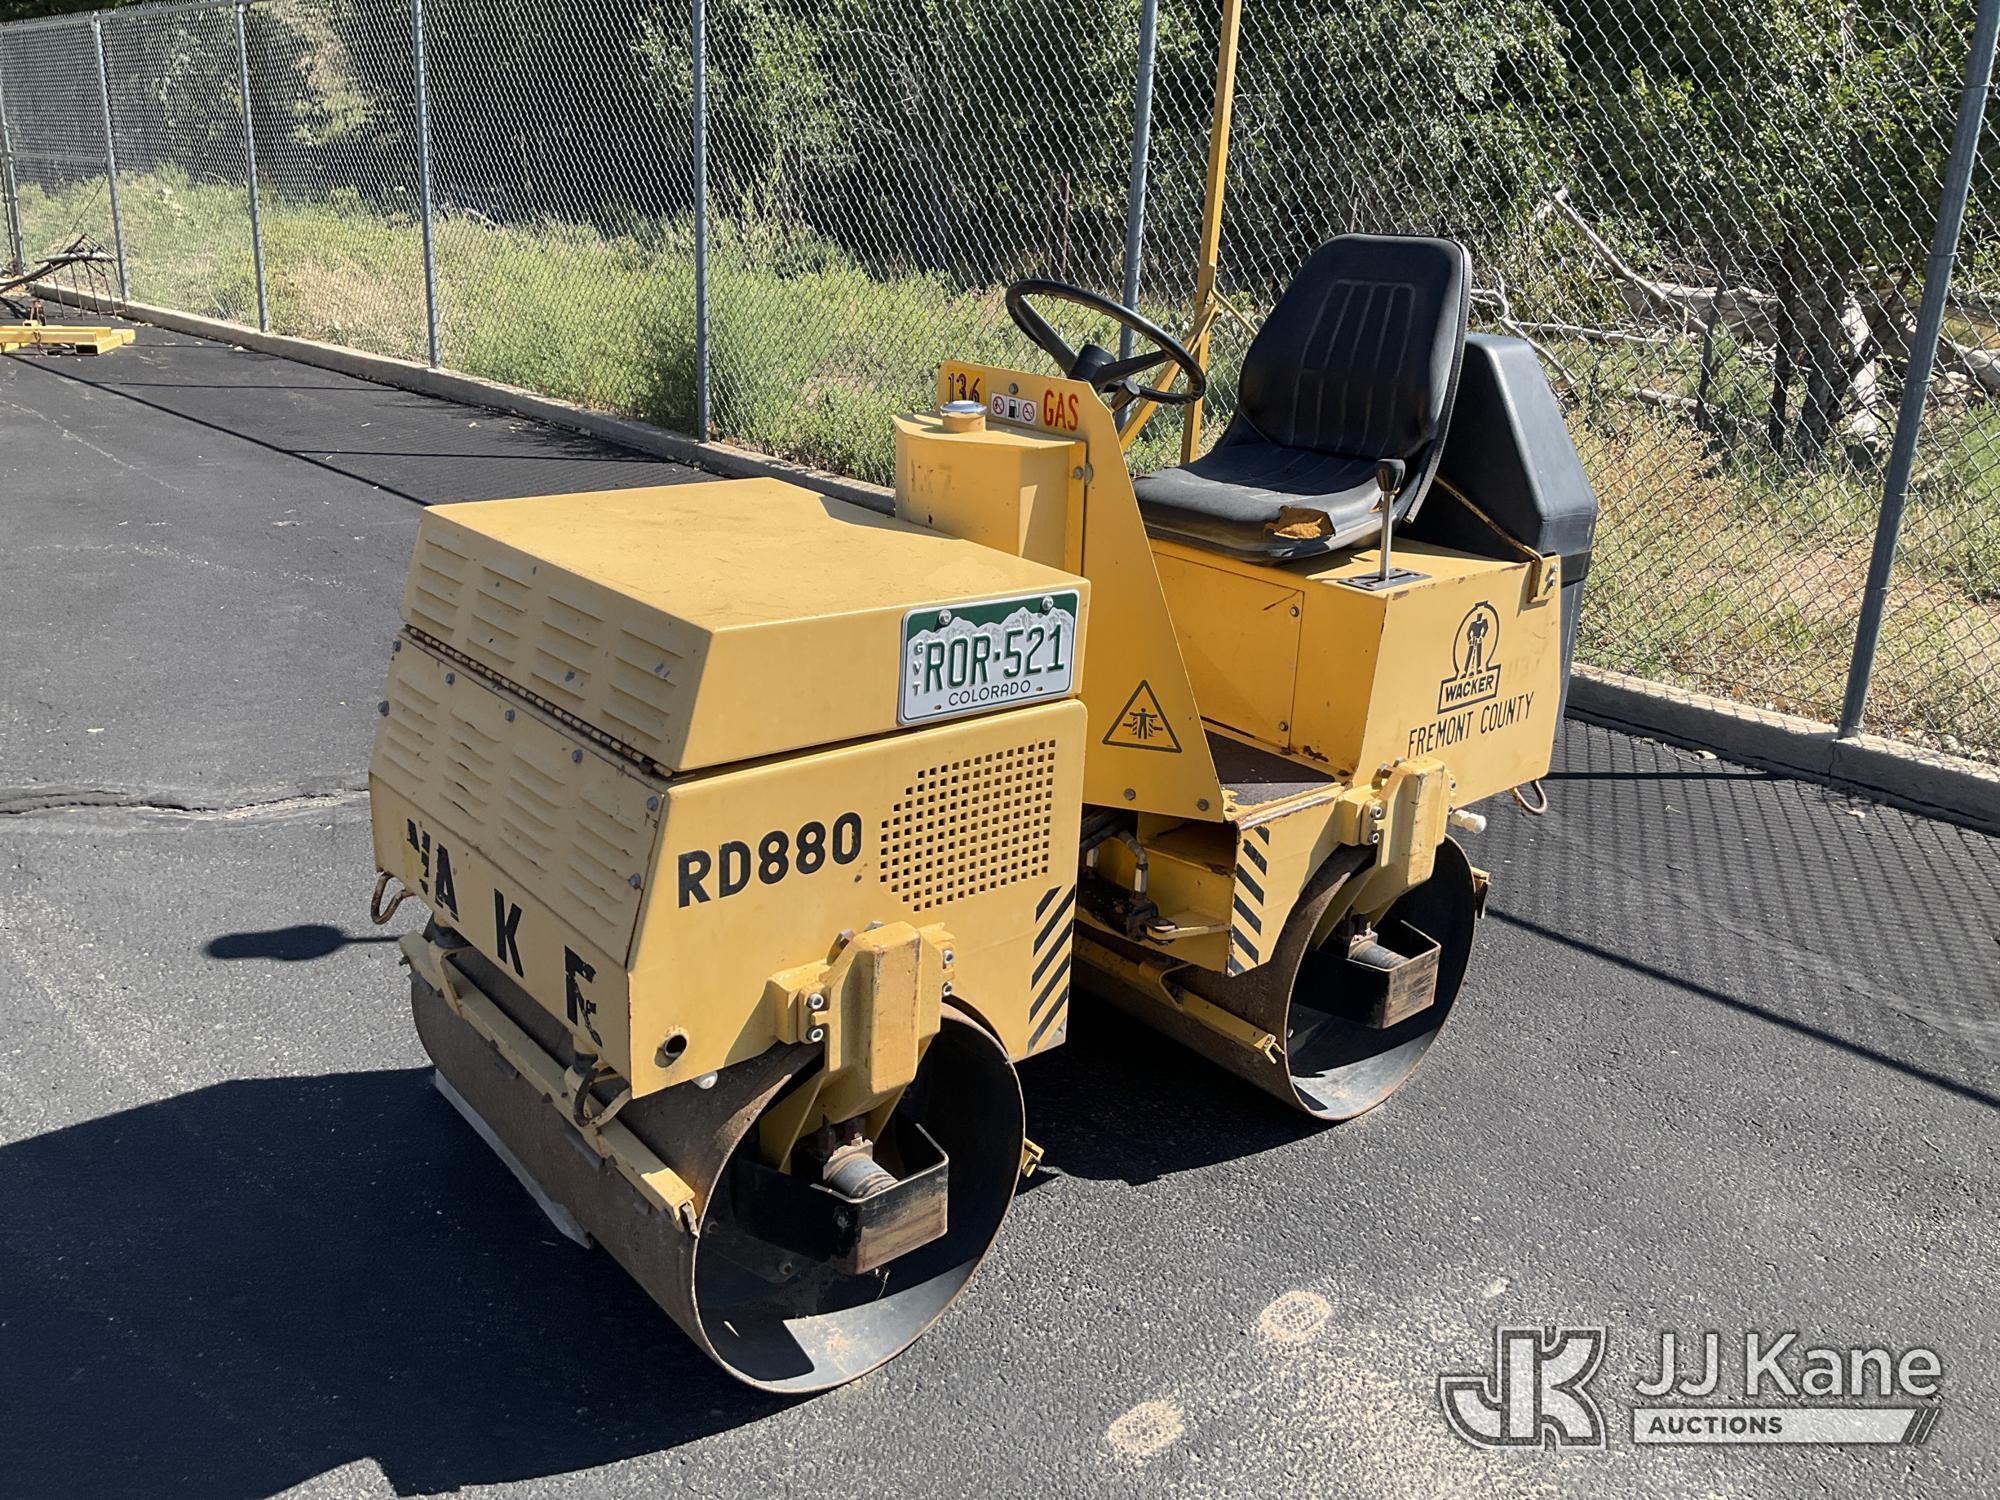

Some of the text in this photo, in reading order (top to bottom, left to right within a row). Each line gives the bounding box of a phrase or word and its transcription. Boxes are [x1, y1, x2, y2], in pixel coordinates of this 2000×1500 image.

[948, 372, 981, 402] 136
[1043, 388, 1079, 431] GAS
[948, 680, 1031, 706] COLORADO
[1445, 674, 1494, 703] WACKER
[1407, 691, 1535, 759] FREMONT COUNTY
[678, 811, 862, 909] RD880
